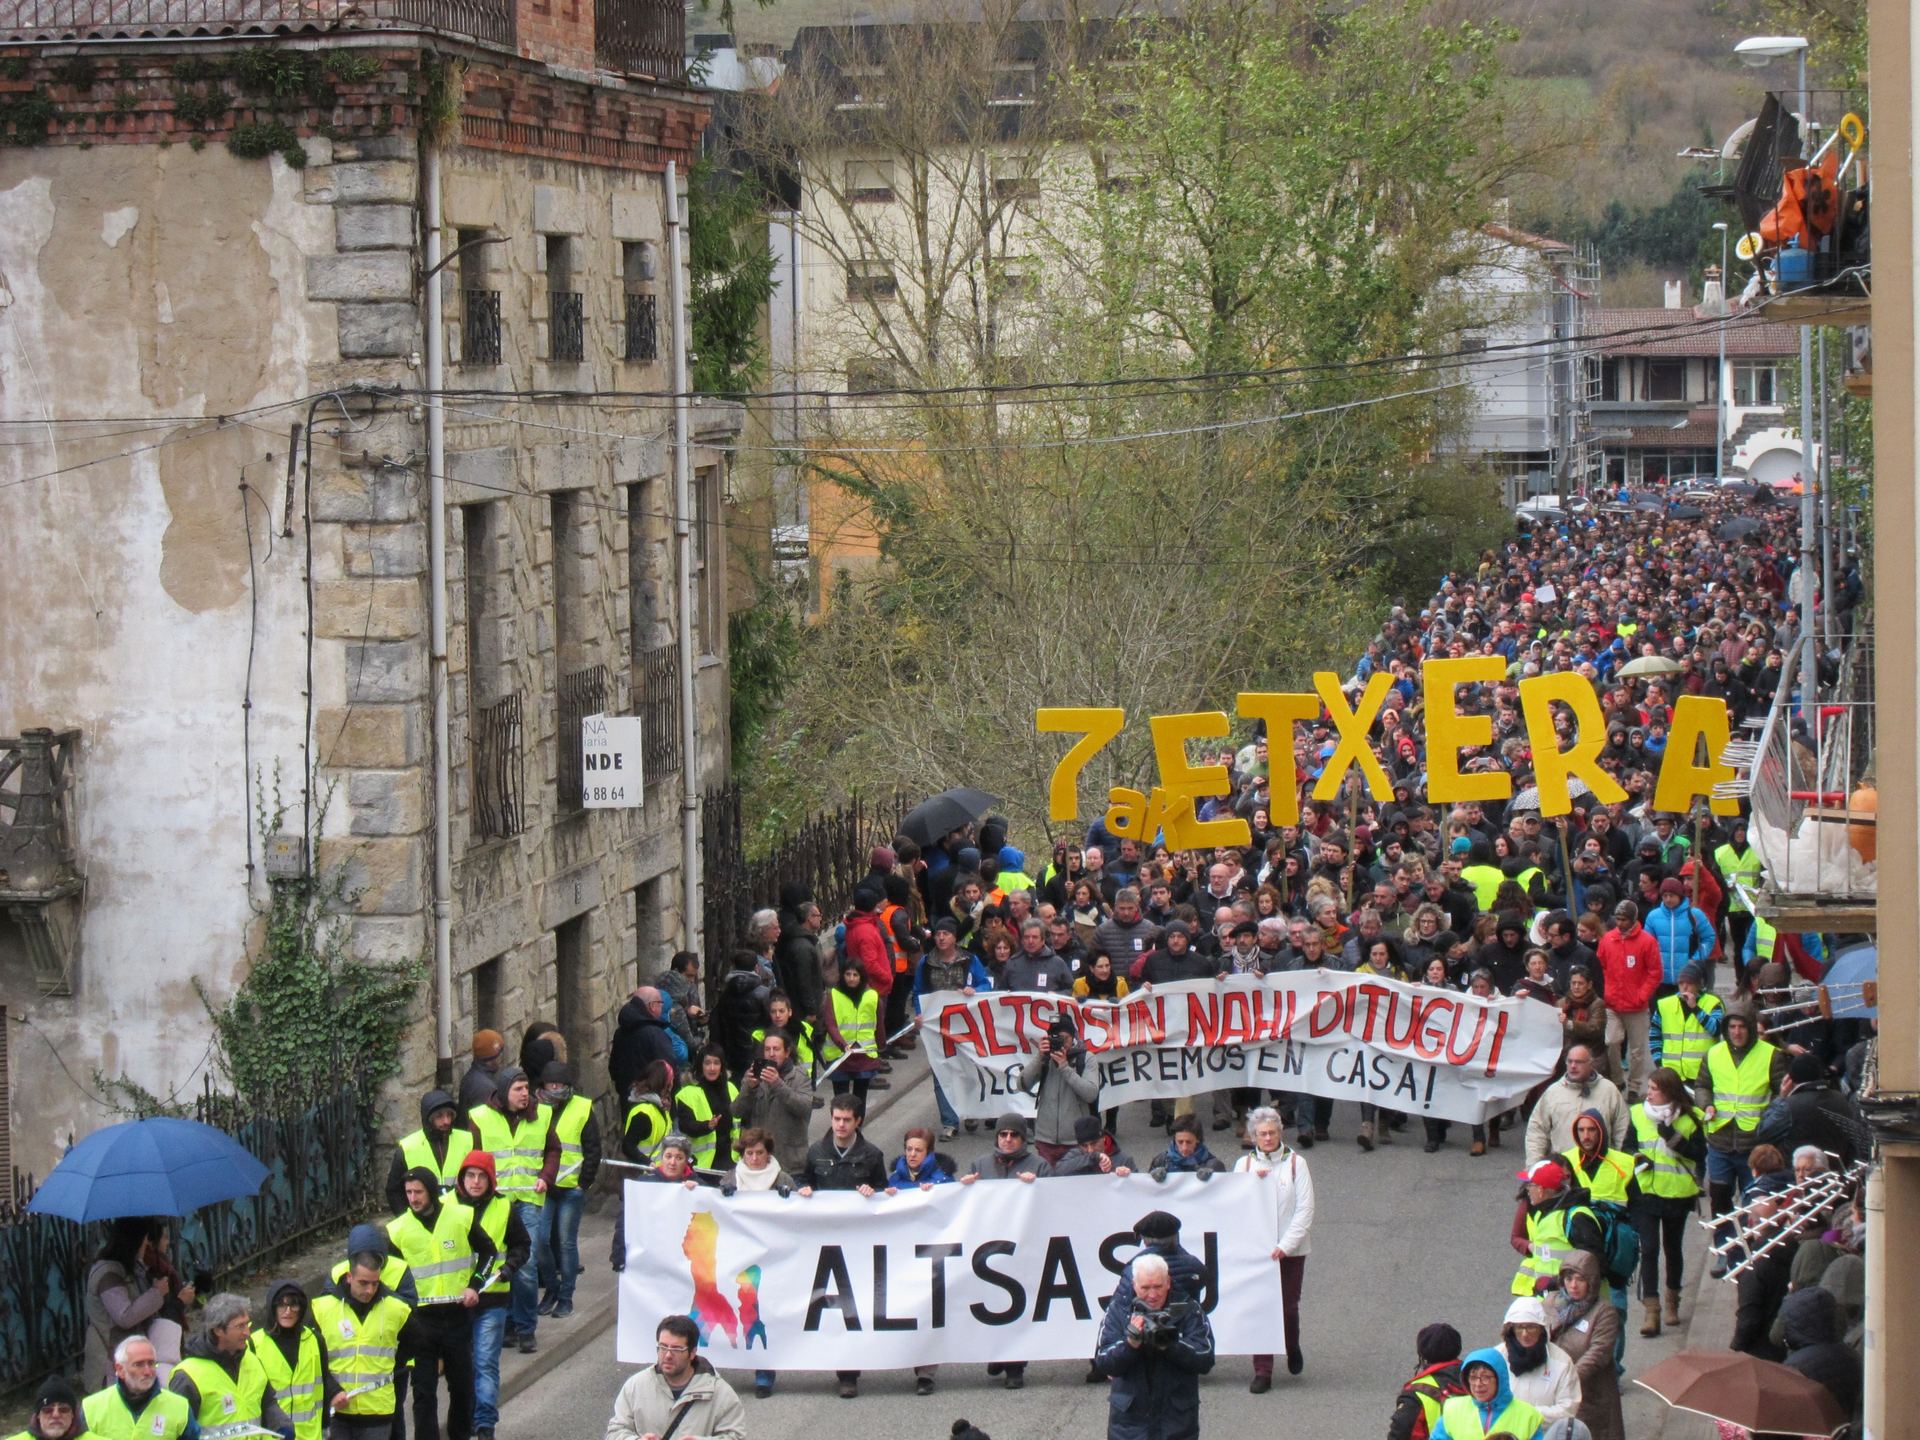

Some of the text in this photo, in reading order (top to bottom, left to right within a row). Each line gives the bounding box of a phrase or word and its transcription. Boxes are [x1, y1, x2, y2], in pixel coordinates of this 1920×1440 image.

[594, 787, 607, 800] 88
[611, 787, 624, 800] 64
[1185, 989, 1296, 1047] NAHI
[1097, 1043, 1246, 1090] EREMOS
[1258, 1042, 1306, 1076] EN
[1326, 1047, 1437, 1110] CASA!
